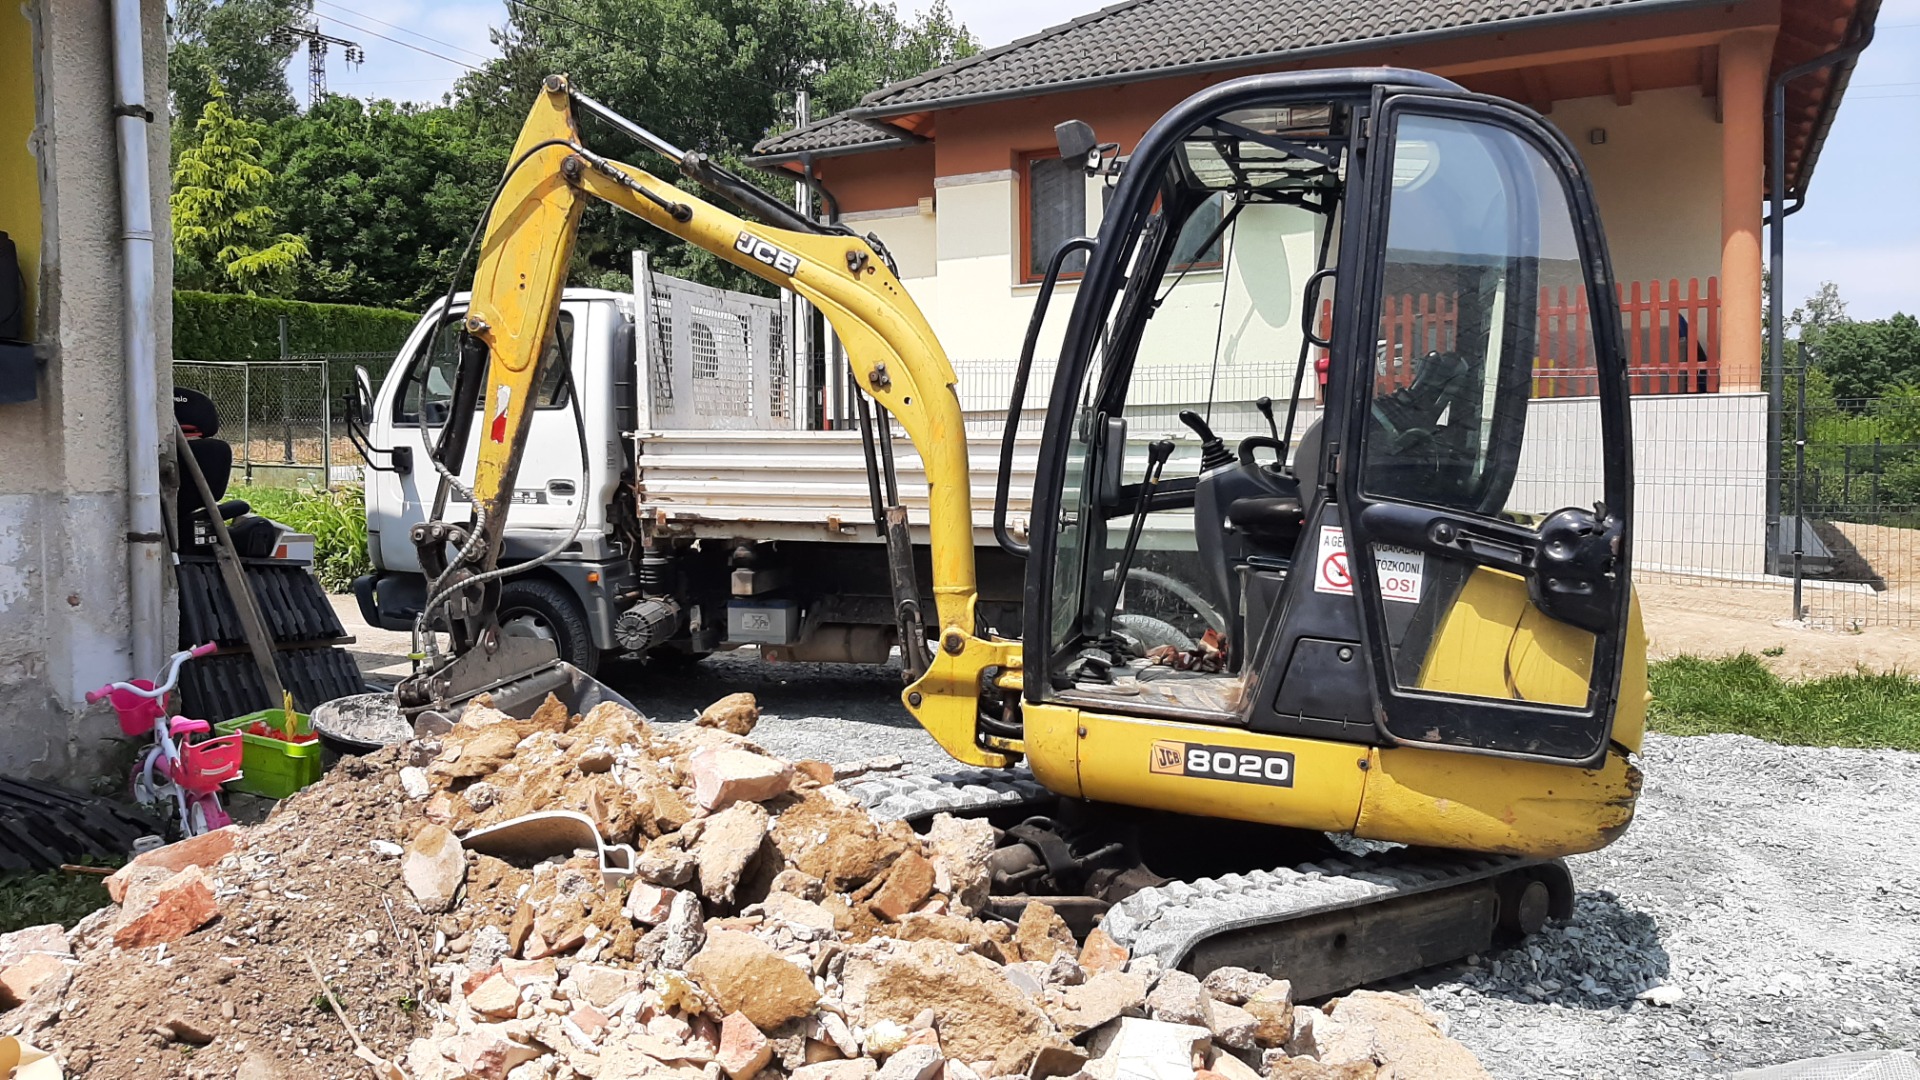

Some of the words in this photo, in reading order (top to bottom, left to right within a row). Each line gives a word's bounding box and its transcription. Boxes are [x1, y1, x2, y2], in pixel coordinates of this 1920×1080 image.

[736, 237, 798, 275] JCB
[1323, 535, 1330, 546] A
[1331, 533, 1345, 548] GÉ
[1158, 747, 1180, 767] JCB
[1187, 748, 1289, 781] 8020
